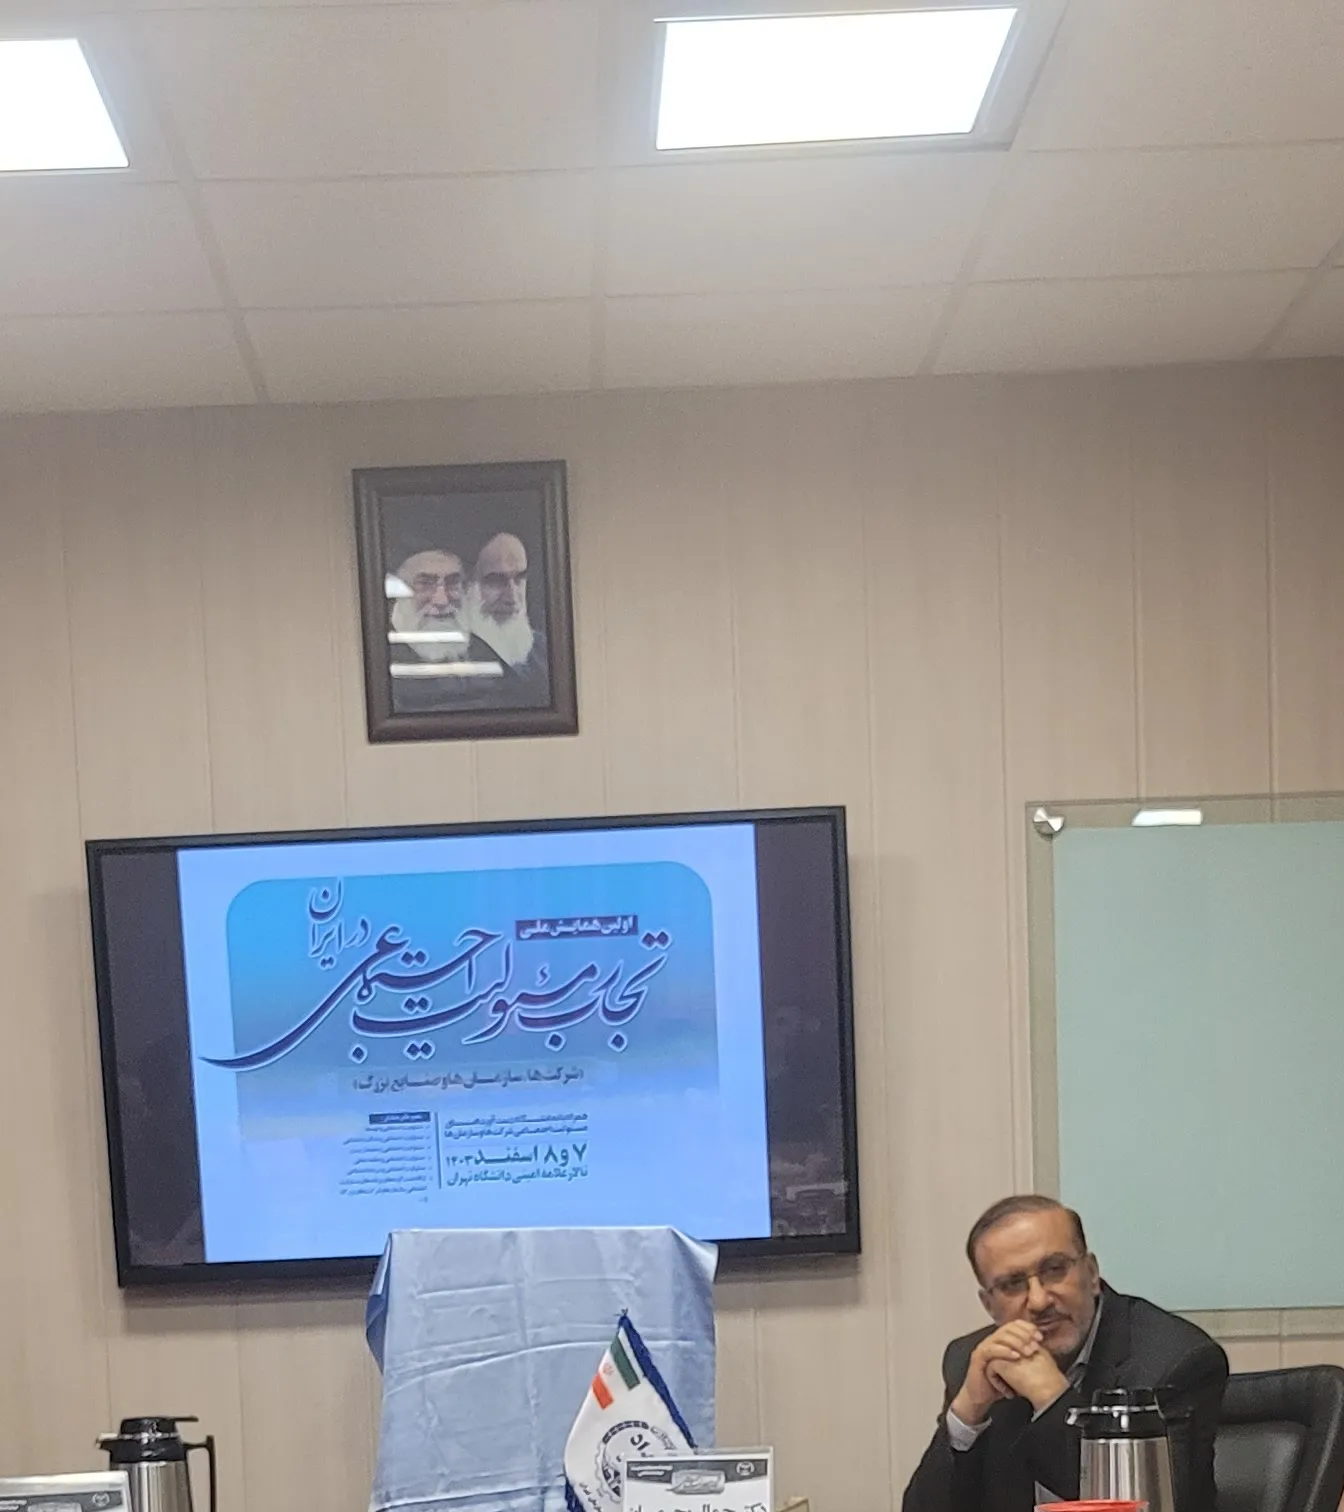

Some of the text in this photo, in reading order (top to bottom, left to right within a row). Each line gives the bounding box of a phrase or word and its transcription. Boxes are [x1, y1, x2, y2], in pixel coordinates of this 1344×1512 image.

[519, 915, 634, 940] اولین همایش ملی
[474, 1145, 538, 1165] اسفند
[544, 1145, 558, 1164] ۸
[559, 1148, 569, 1167] و
[573, 1143, 587, 1162] ۷
